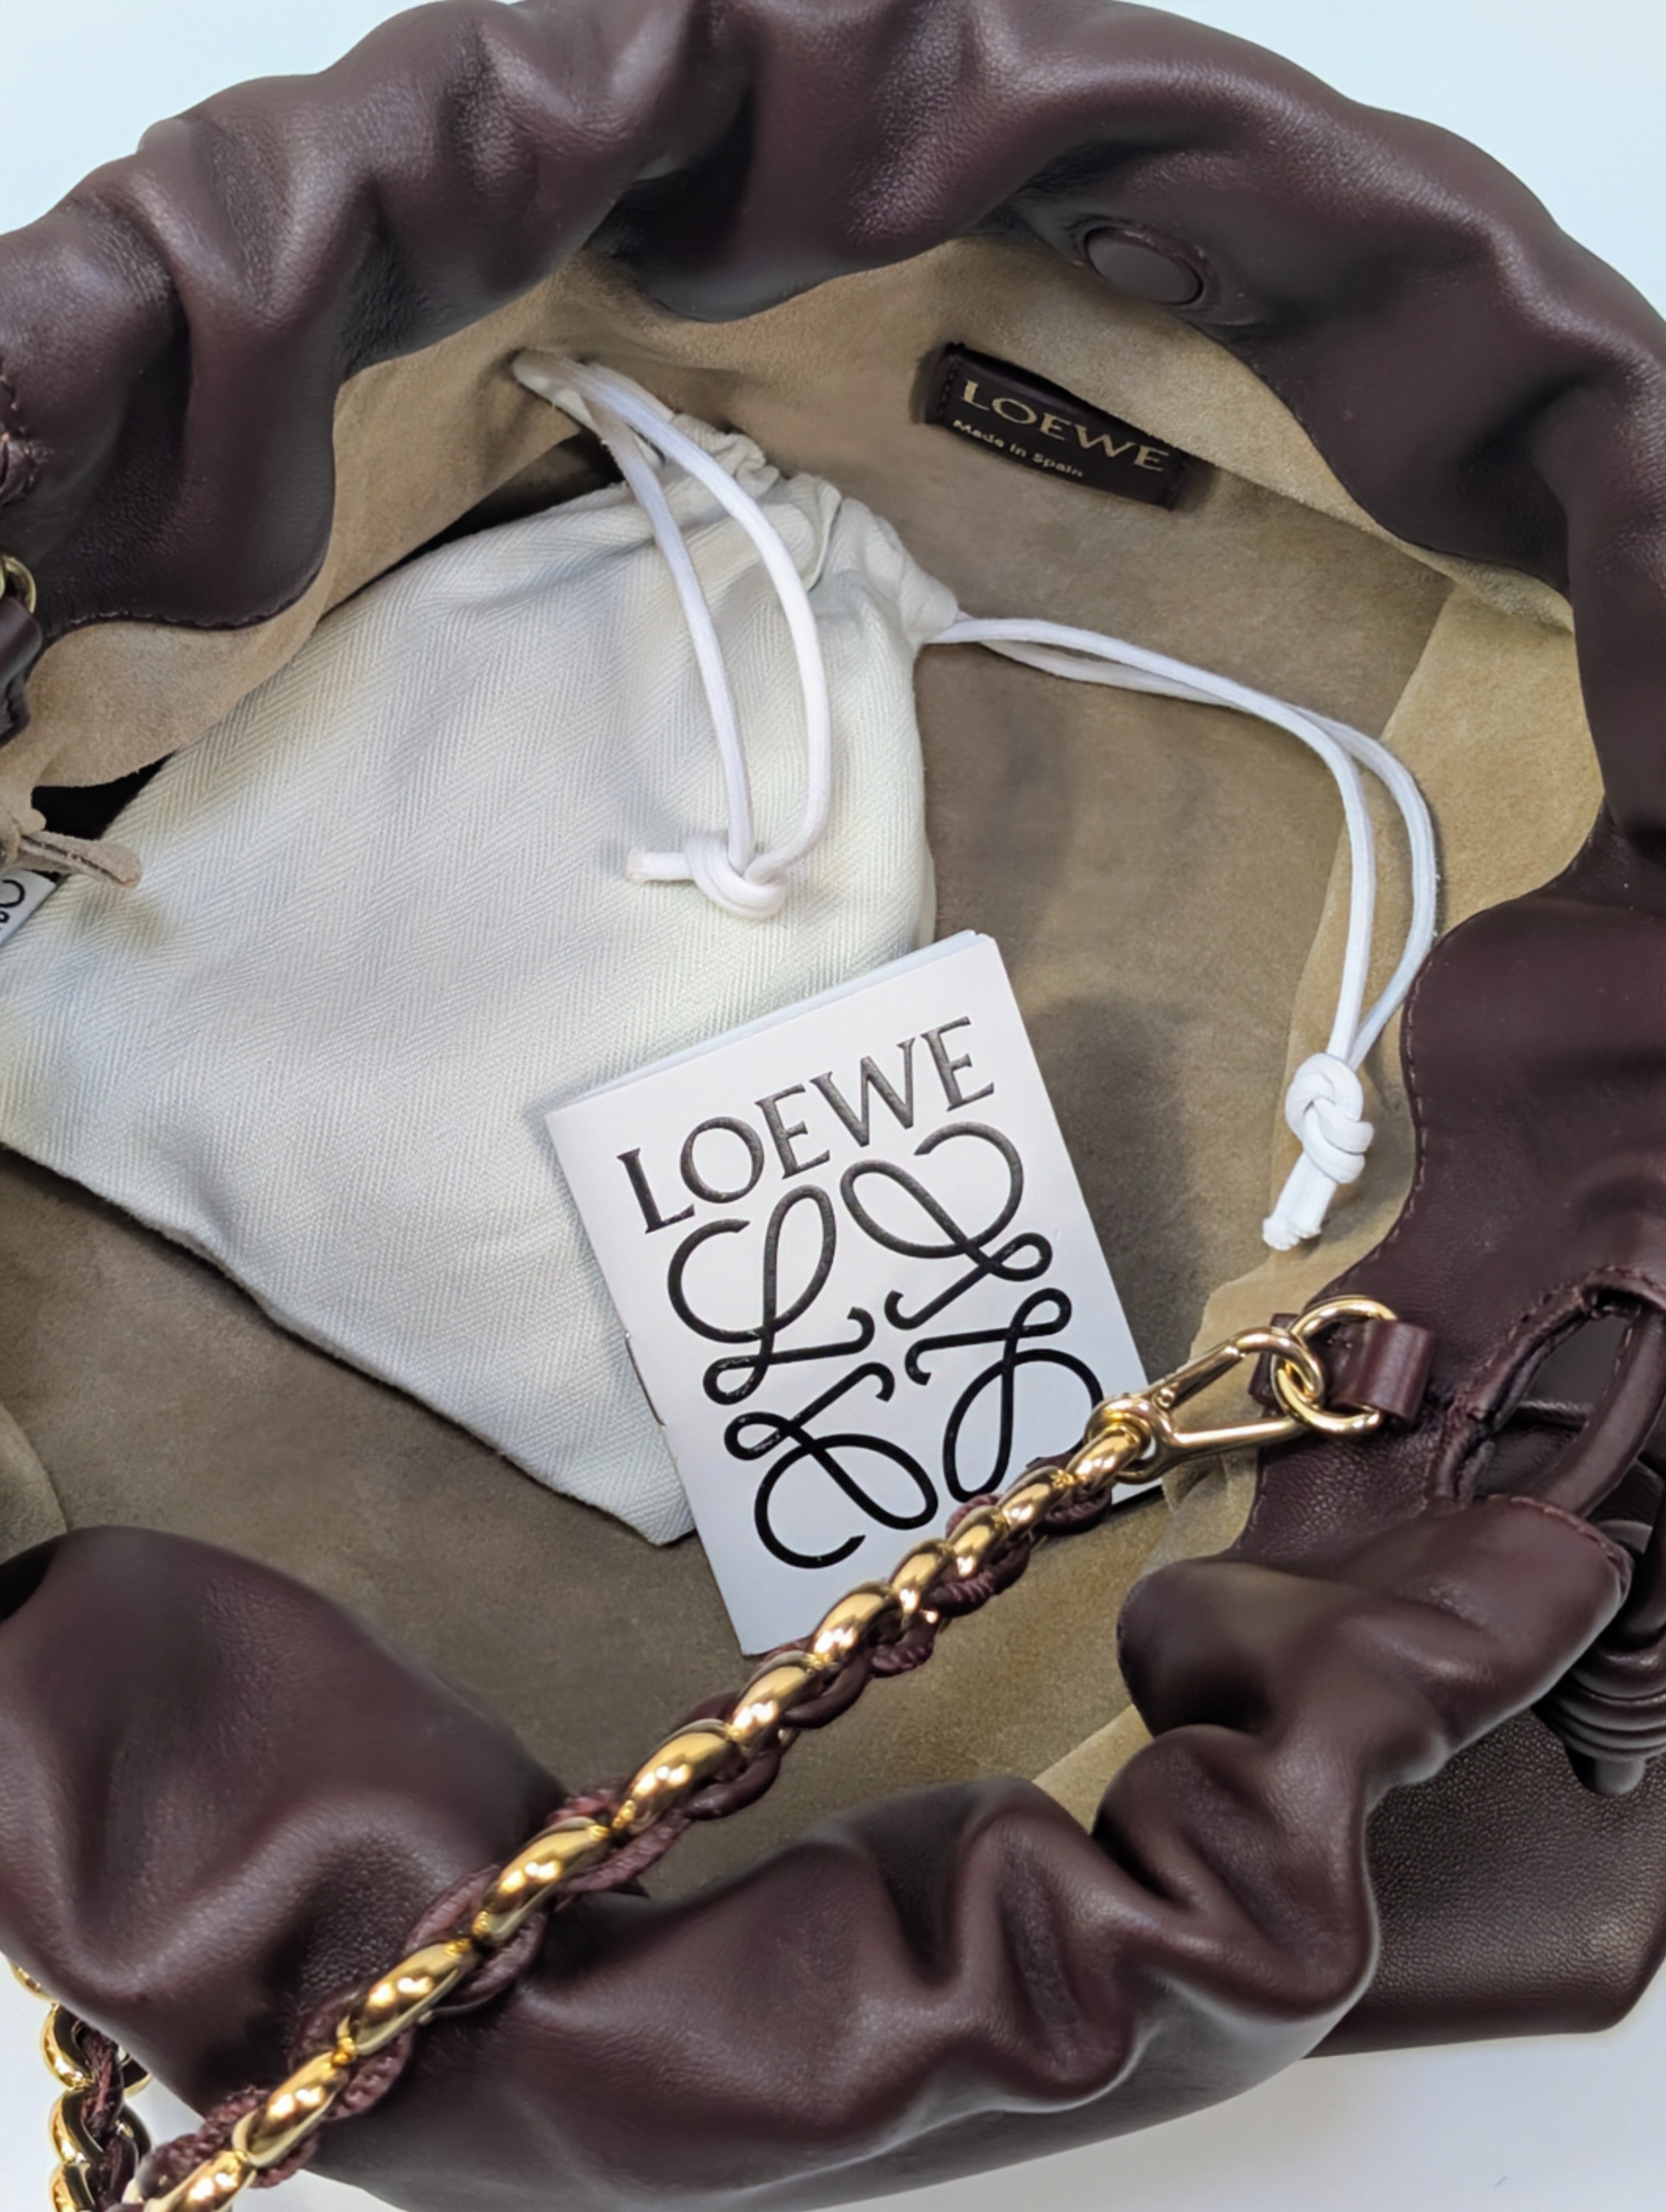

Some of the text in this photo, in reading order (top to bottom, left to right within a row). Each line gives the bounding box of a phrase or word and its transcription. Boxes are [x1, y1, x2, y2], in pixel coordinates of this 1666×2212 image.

[953, 419, 1084, 478] Made in Spain
[961, 380, 1170, 472] LOEWE
[616, 1015, 995, 1234] LOEWE
